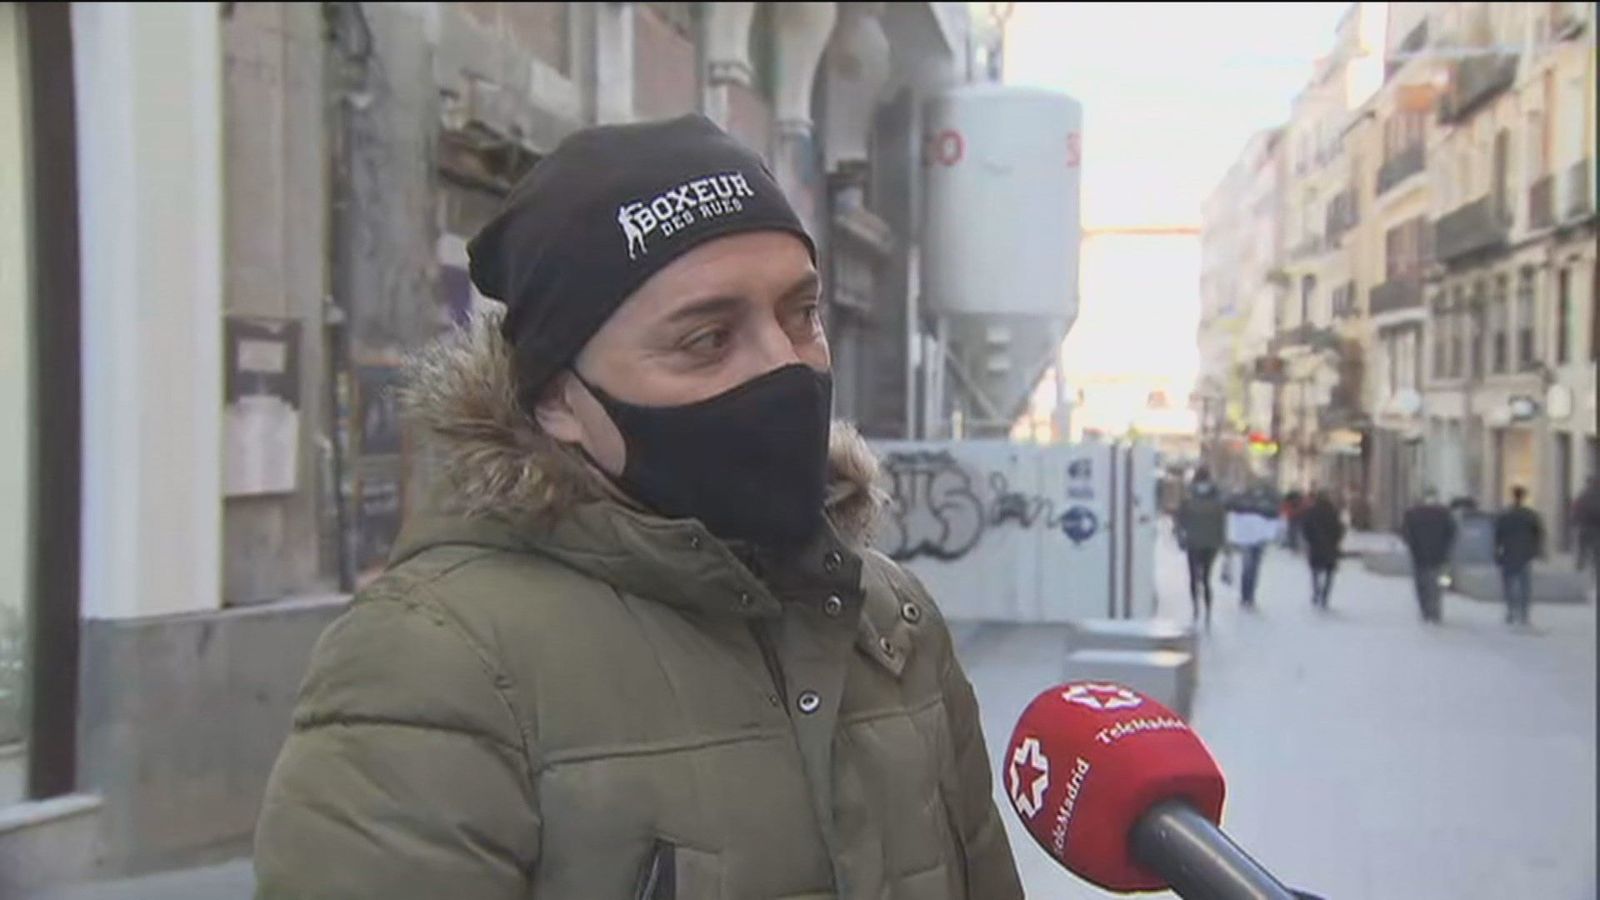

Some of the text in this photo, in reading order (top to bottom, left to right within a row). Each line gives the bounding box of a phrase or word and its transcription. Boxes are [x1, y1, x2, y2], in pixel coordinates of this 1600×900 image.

[634, 173, 754, 235] BOXEUR
[660, 197, 743, 236] DES RUES
